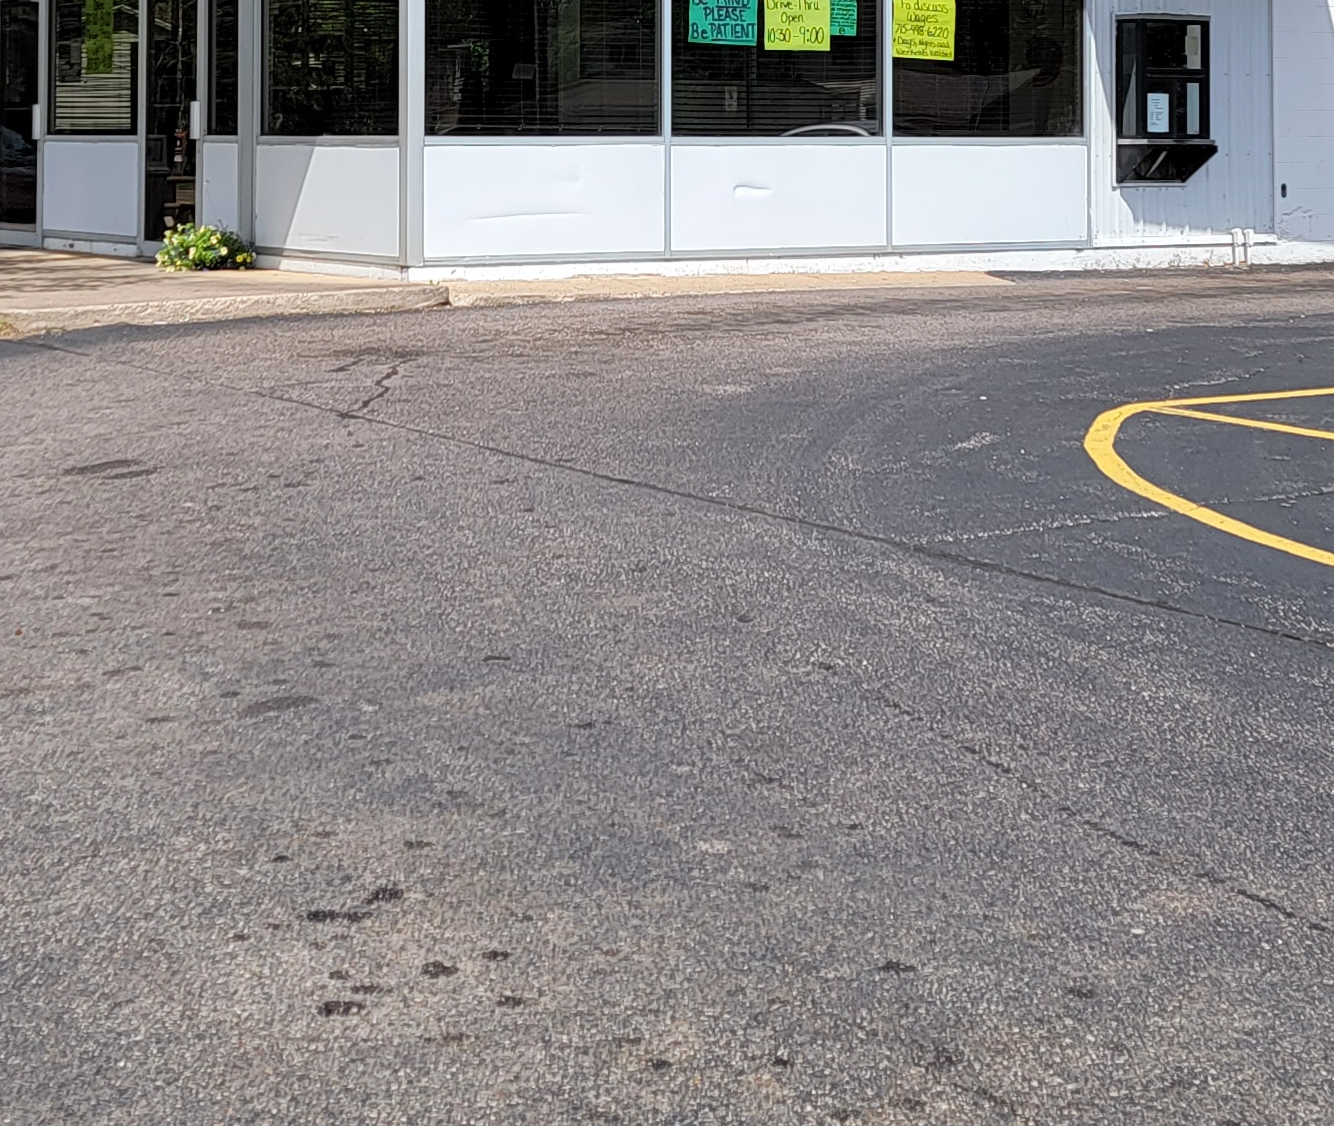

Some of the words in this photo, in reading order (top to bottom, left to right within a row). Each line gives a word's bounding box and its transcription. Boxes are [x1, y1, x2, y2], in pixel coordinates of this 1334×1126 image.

[703, 6, 747, 22] PLEASE
[780, 12, 805, 25] Open
[907, 11, 939, 26] Wages
[691, 22, 709, 39] Be
[708, 23, 757, 40] PATIENT
